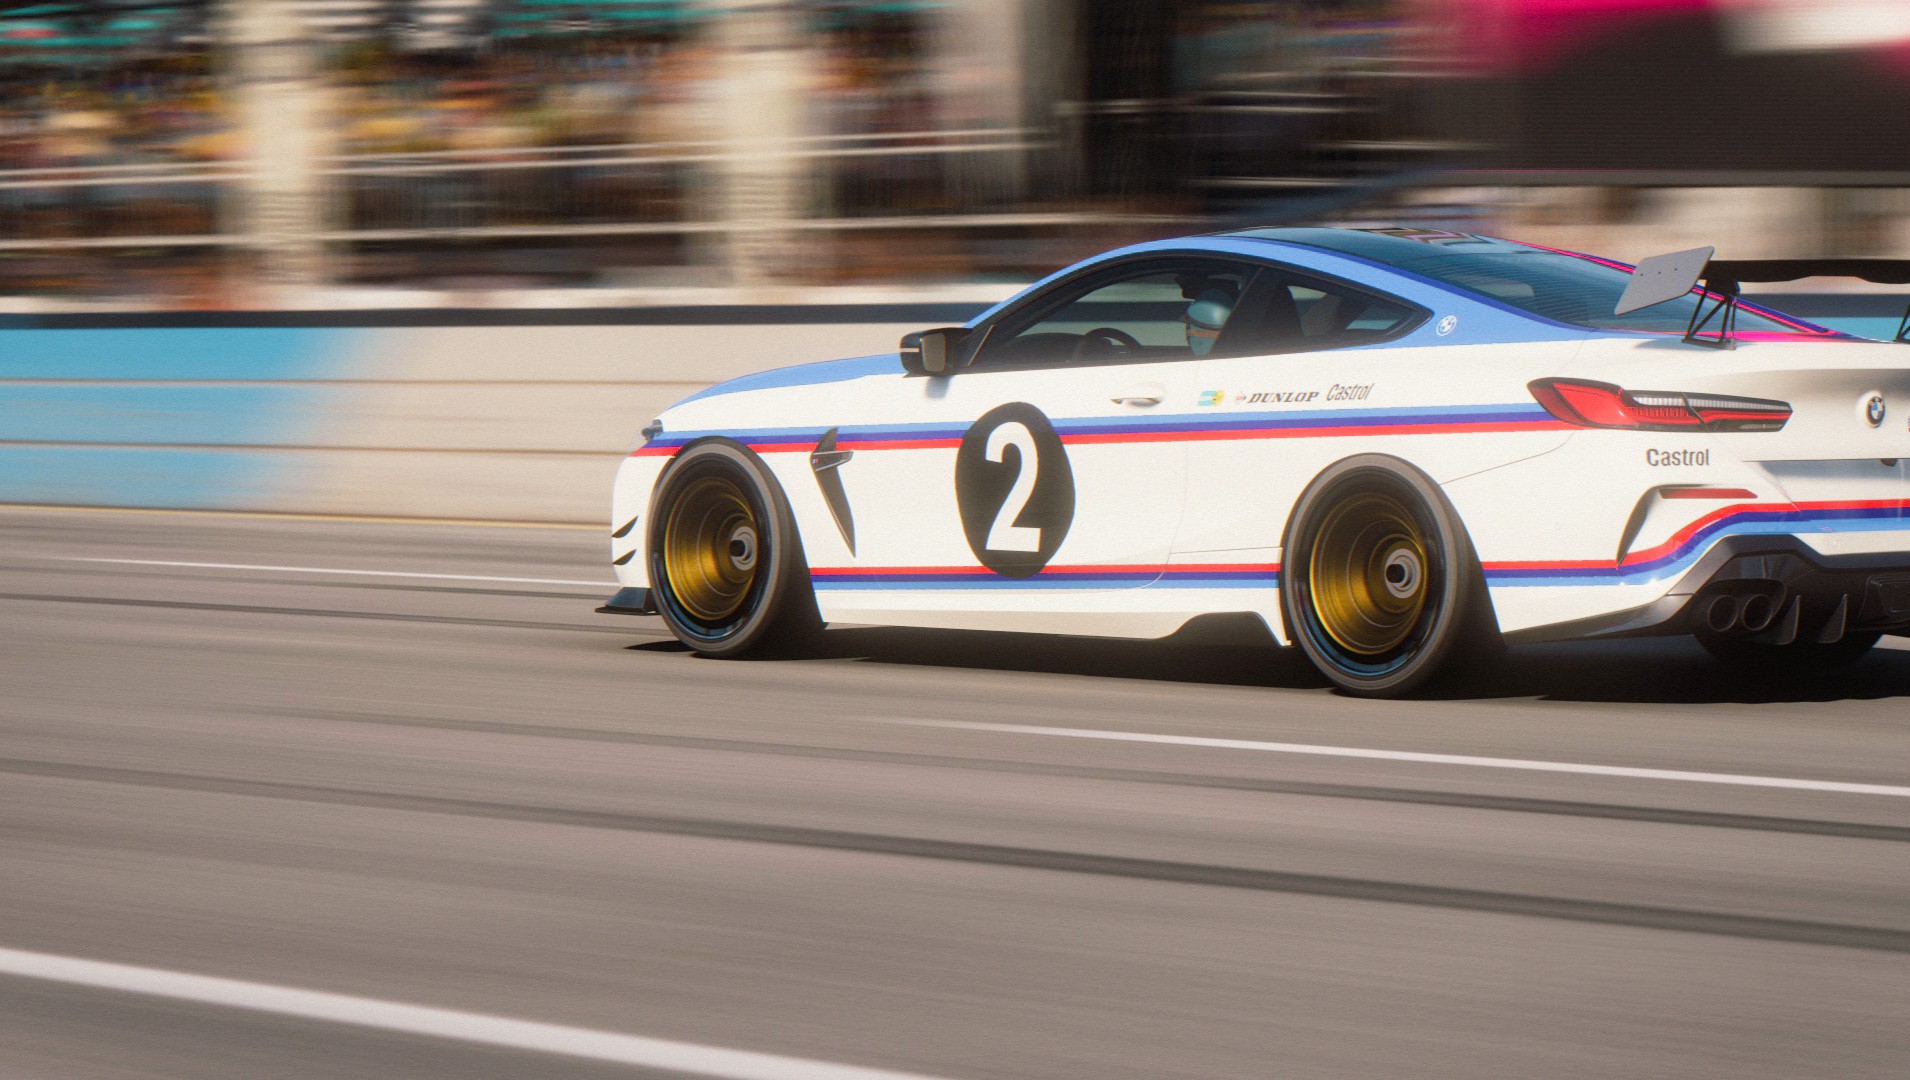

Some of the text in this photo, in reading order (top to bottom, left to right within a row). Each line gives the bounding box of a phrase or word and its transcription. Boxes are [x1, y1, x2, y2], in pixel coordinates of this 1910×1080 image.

[1248, 392, 1319, 403] DUNLOP
[1327, 383, 1375, 401] Castrol
[1645, 448, 1710, 467] Castrol
[985, 421, 1041, 552] 2
